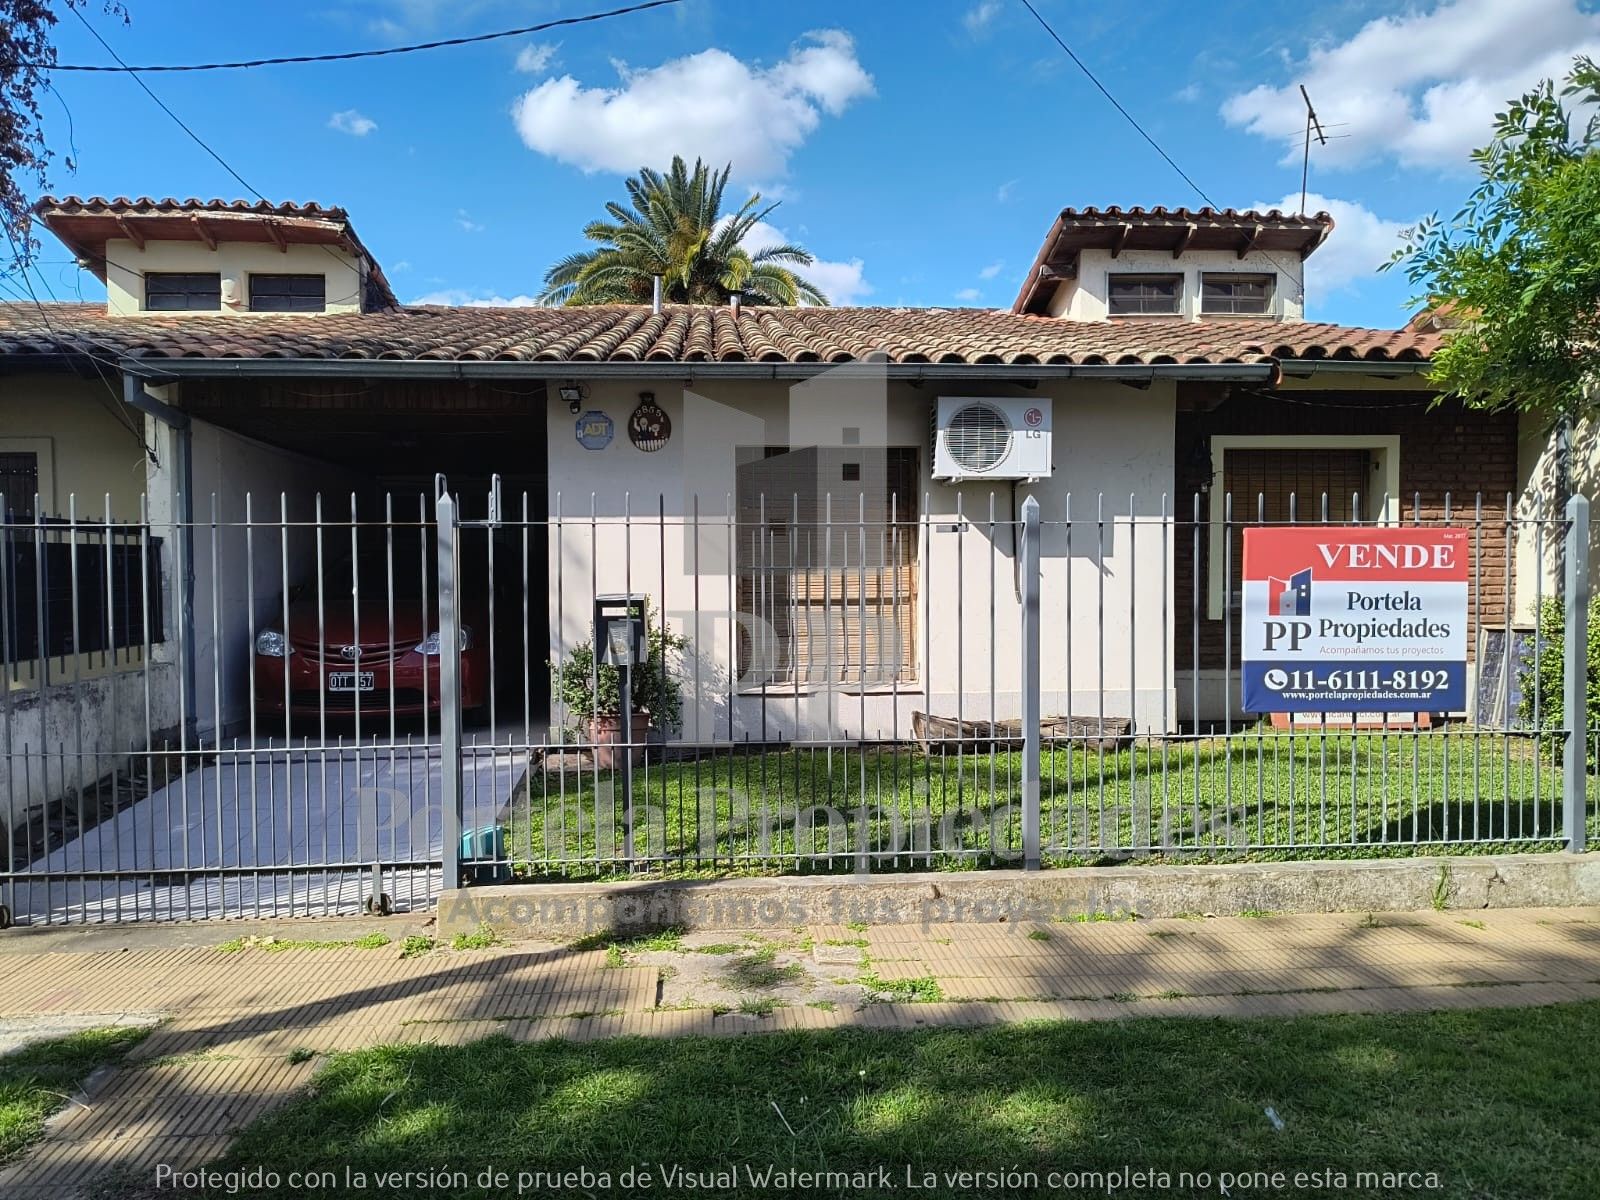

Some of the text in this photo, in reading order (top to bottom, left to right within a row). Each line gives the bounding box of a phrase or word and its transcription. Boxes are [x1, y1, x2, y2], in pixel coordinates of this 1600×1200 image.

[583, 423, 609, 436] ADT
[1025, 430, 1041, 439] LG
[1316, 543, 1456, 569] VENDE
[1347, 590, 1422, 611] Portela
[1262, 621, 1312, 651] PP
[1319, 617, 1451, 643] Propiedades
[1320, 645, 1444, 657] Acompañamos tus proyectos
[1290, 670, 1449, 690] 11-6111-8192
[1282, 691, 1432, 701] www.portelapropiedades.com.ar
